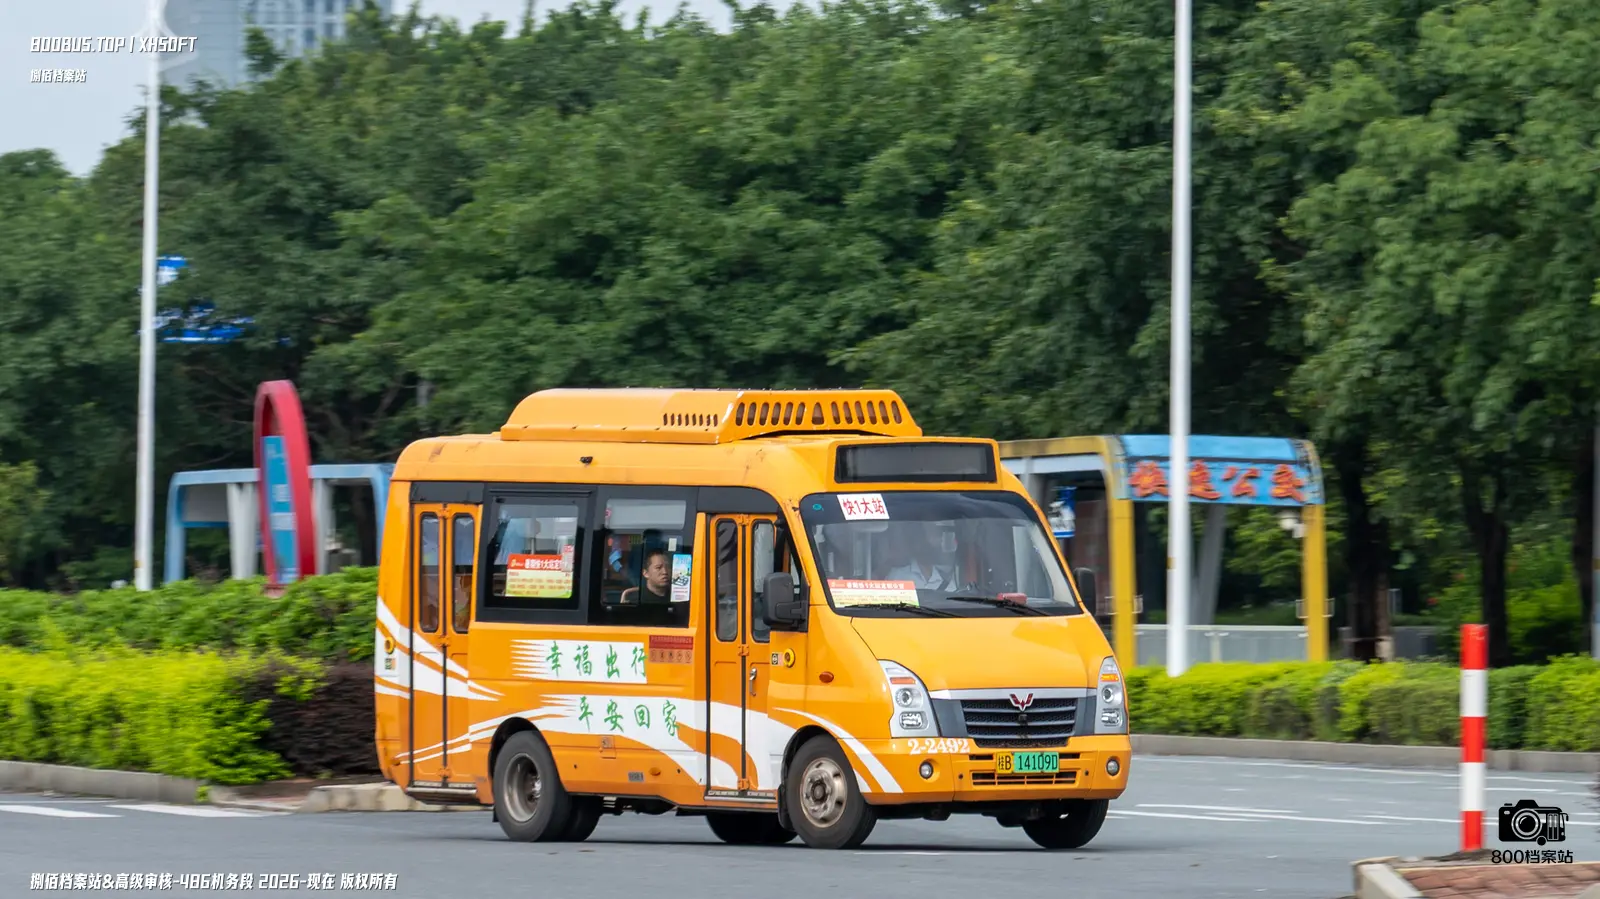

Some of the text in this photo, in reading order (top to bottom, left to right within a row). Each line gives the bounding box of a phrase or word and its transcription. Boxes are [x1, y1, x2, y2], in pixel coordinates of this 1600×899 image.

[842, 497, 886, 515] 快1大站
[546, 640, 648, 679] 幸福出行
[578, 696, 680, 737] 平安回家
[907, 737, 971, 755] 2-2492
[1018, 753, 1058, 771] 14109D
